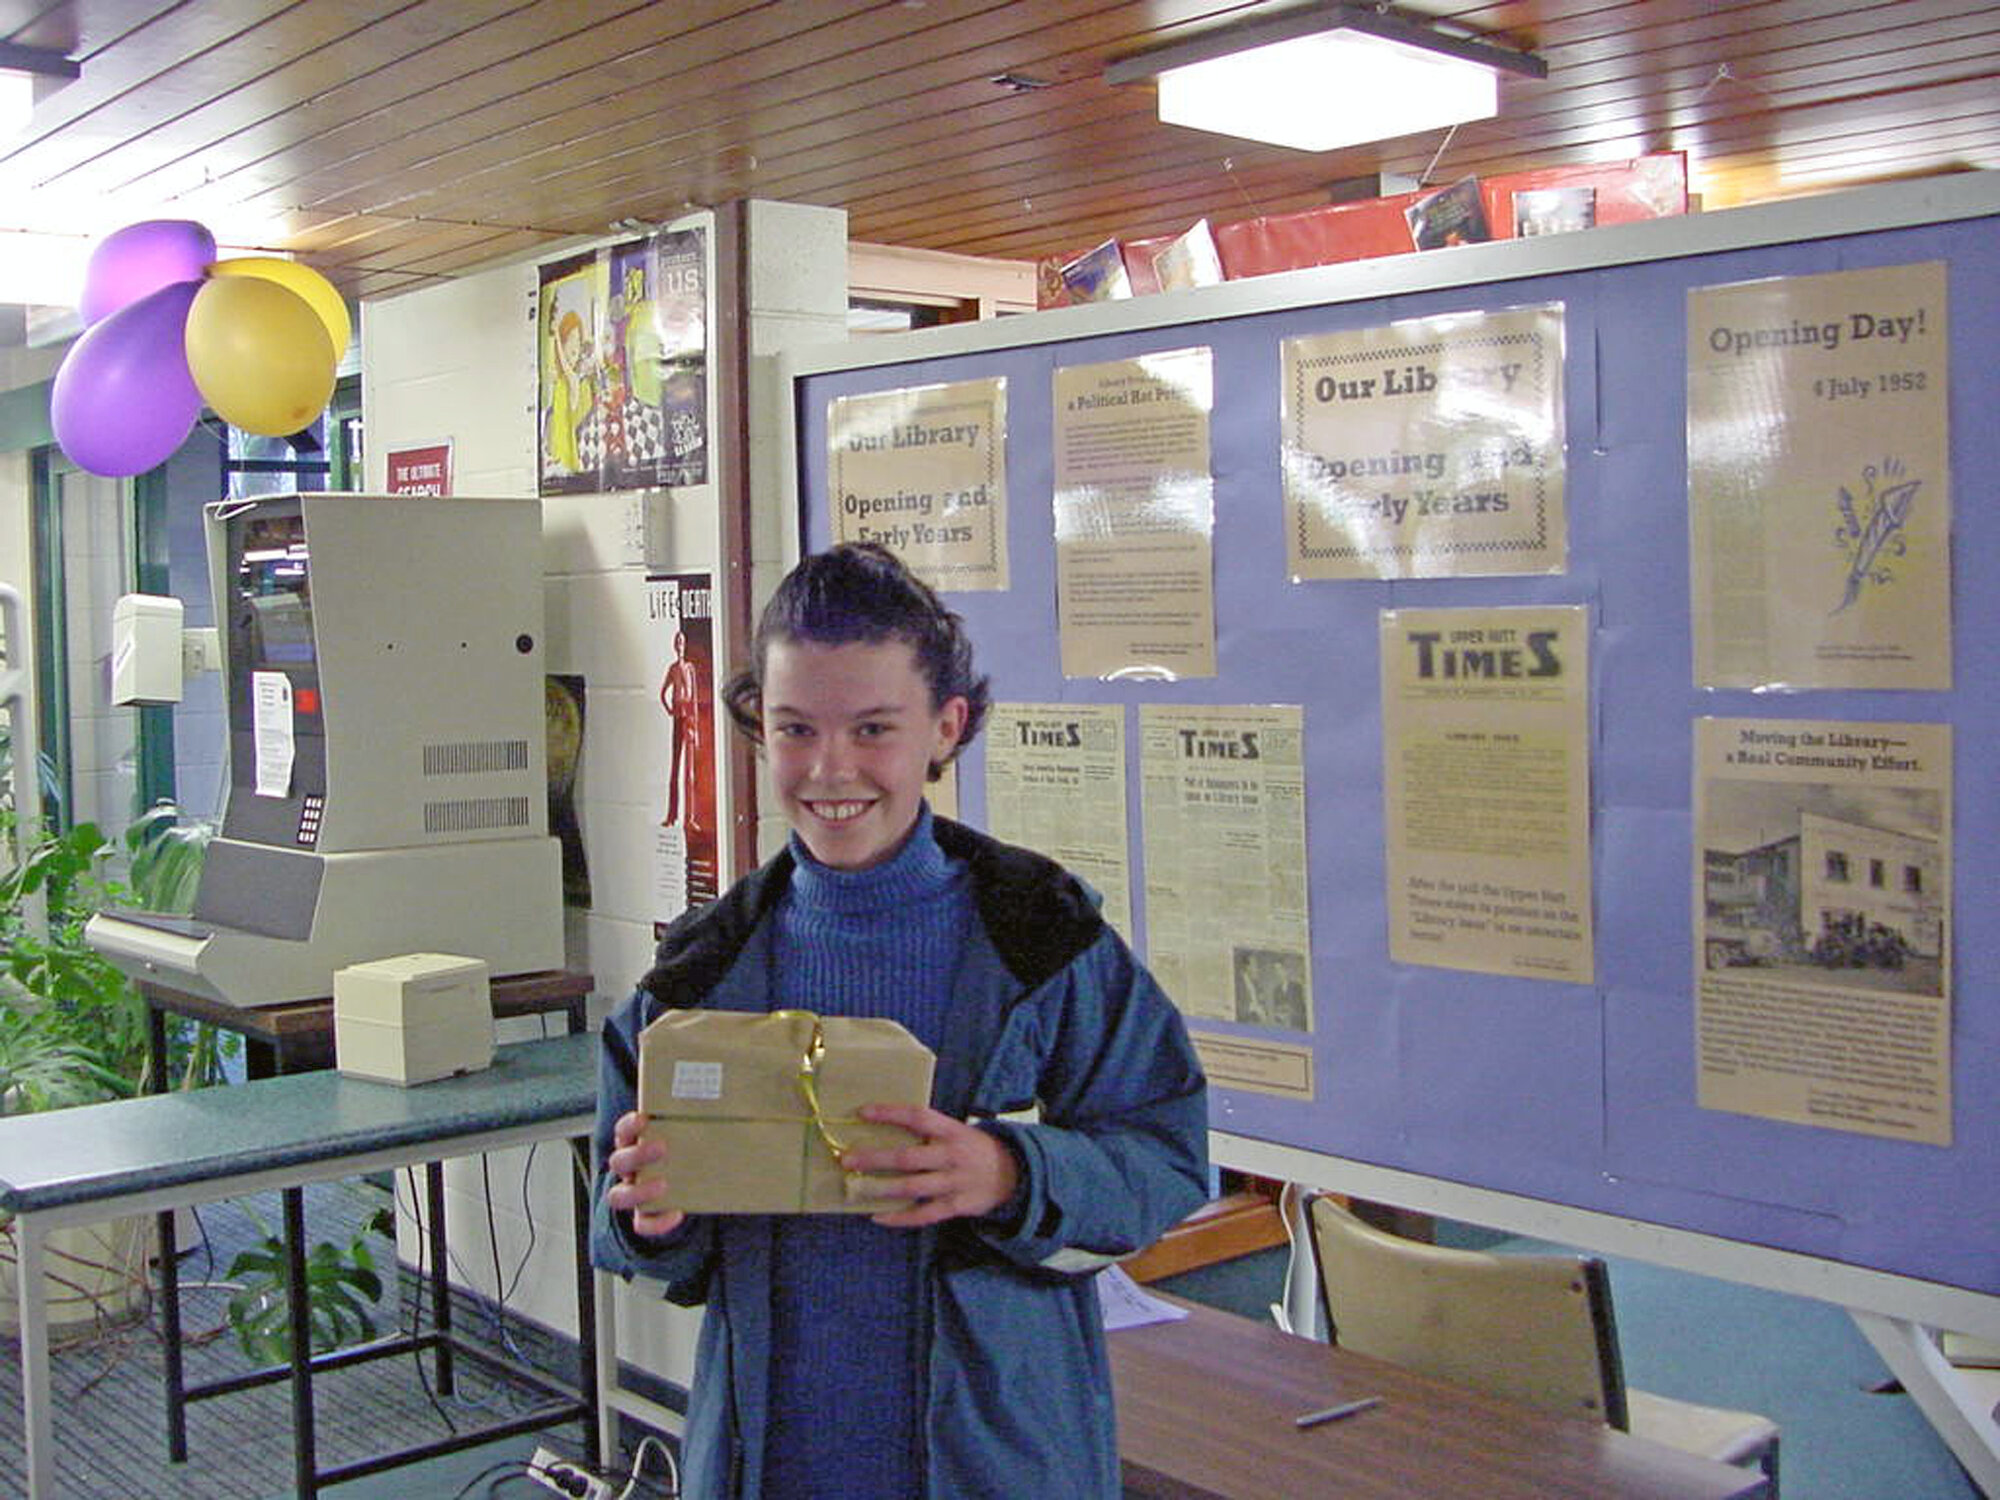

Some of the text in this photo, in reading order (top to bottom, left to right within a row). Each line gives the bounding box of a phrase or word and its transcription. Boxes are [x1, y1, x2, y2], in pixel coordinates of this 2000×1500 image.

[1709, 308, 1927, 356] Opening Day!
[1314, 373, 1377, 403] Our
[1826, 377, 1872, 400] July
[1878, 372, 1928, 392] 1952
[1077, 391, 1128, 411] Political
[892, 424, 980, 447] Library
[845, 491, 932, 519] Opening
[1414, 489, 1510, 517] Years
[912, 523, 973, 545] Years
[1407, 631, 1562, 679] TIMES
[1016, 720, 1082, 748] TIMES
[1179, 728, 1260, 760] TIMES
[1739, 730, 1796, 748] Moving
[1801, 732, 1825, 746] the
[1737, 751, 1771, 765] Real
[1774, 752, 1867, 770] Community
